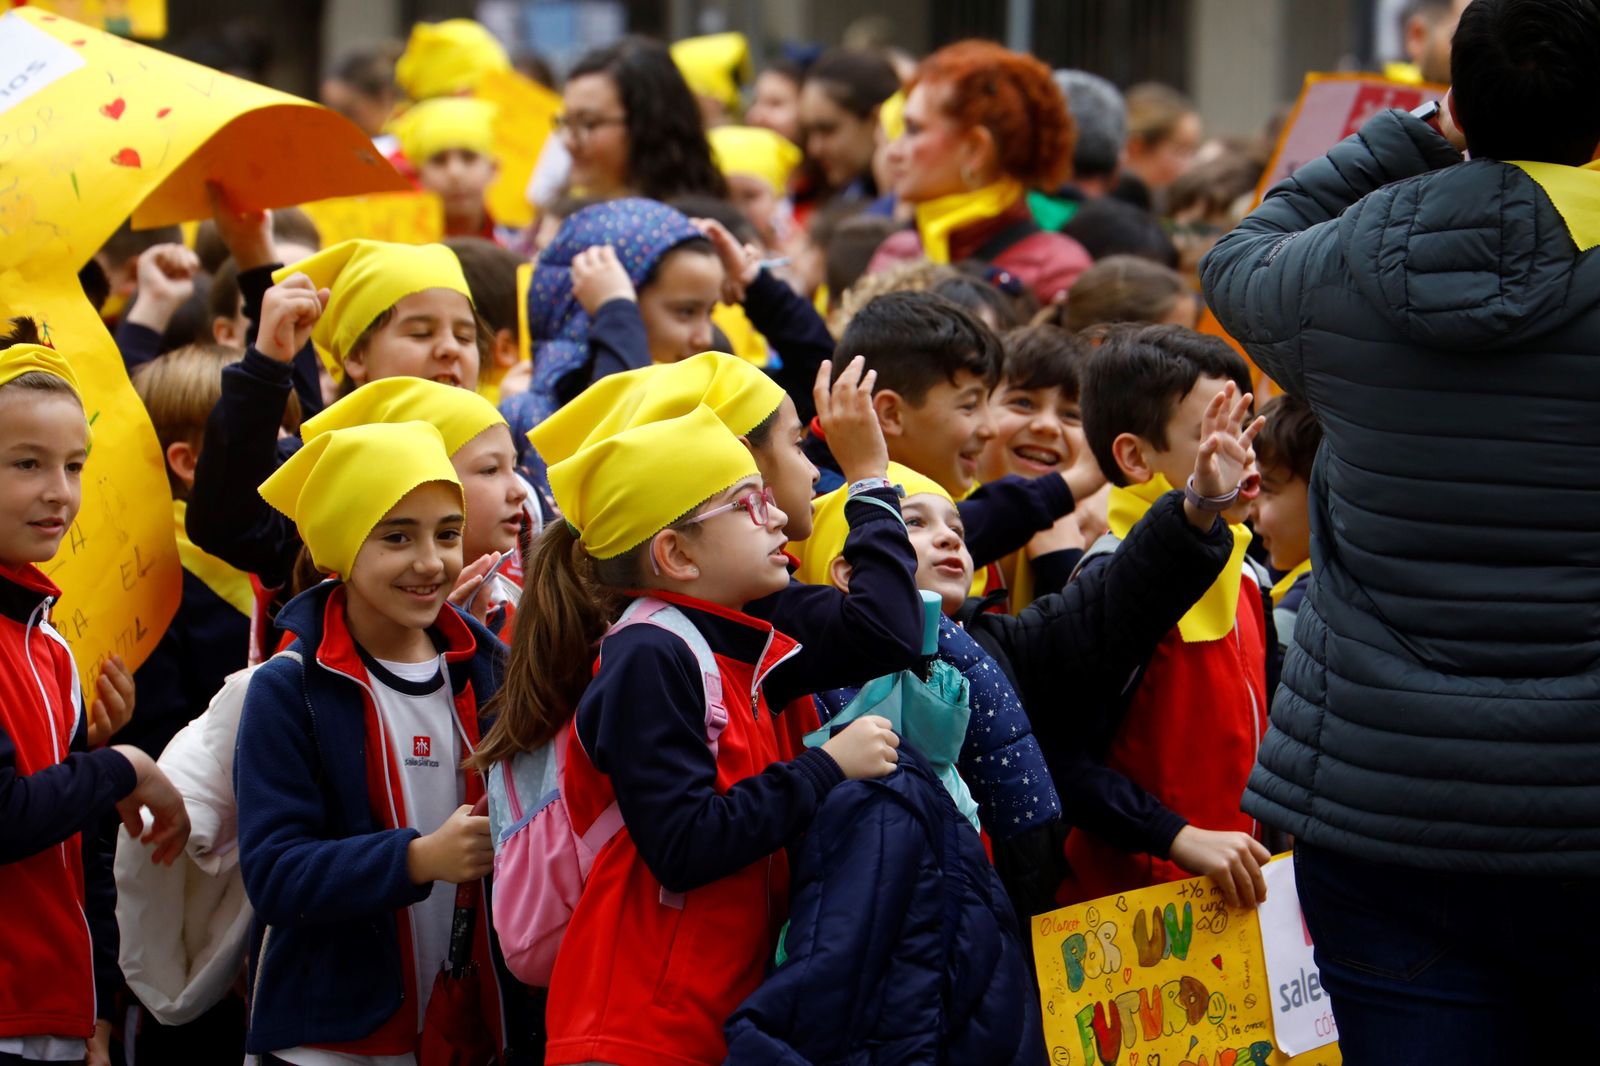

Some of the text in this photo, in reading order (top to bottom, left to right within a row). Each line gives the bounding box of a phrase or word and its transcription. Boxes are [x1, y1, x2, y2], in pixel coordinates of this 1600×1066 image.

[119, 545, 157, 593] EL
[1061, 920, 1123, 993] POR
[1131, 900, 1194, 968] UN
[1074, 974, 1211, 1066] FUTURO
[1279, 967, 1332, 1014] sale
